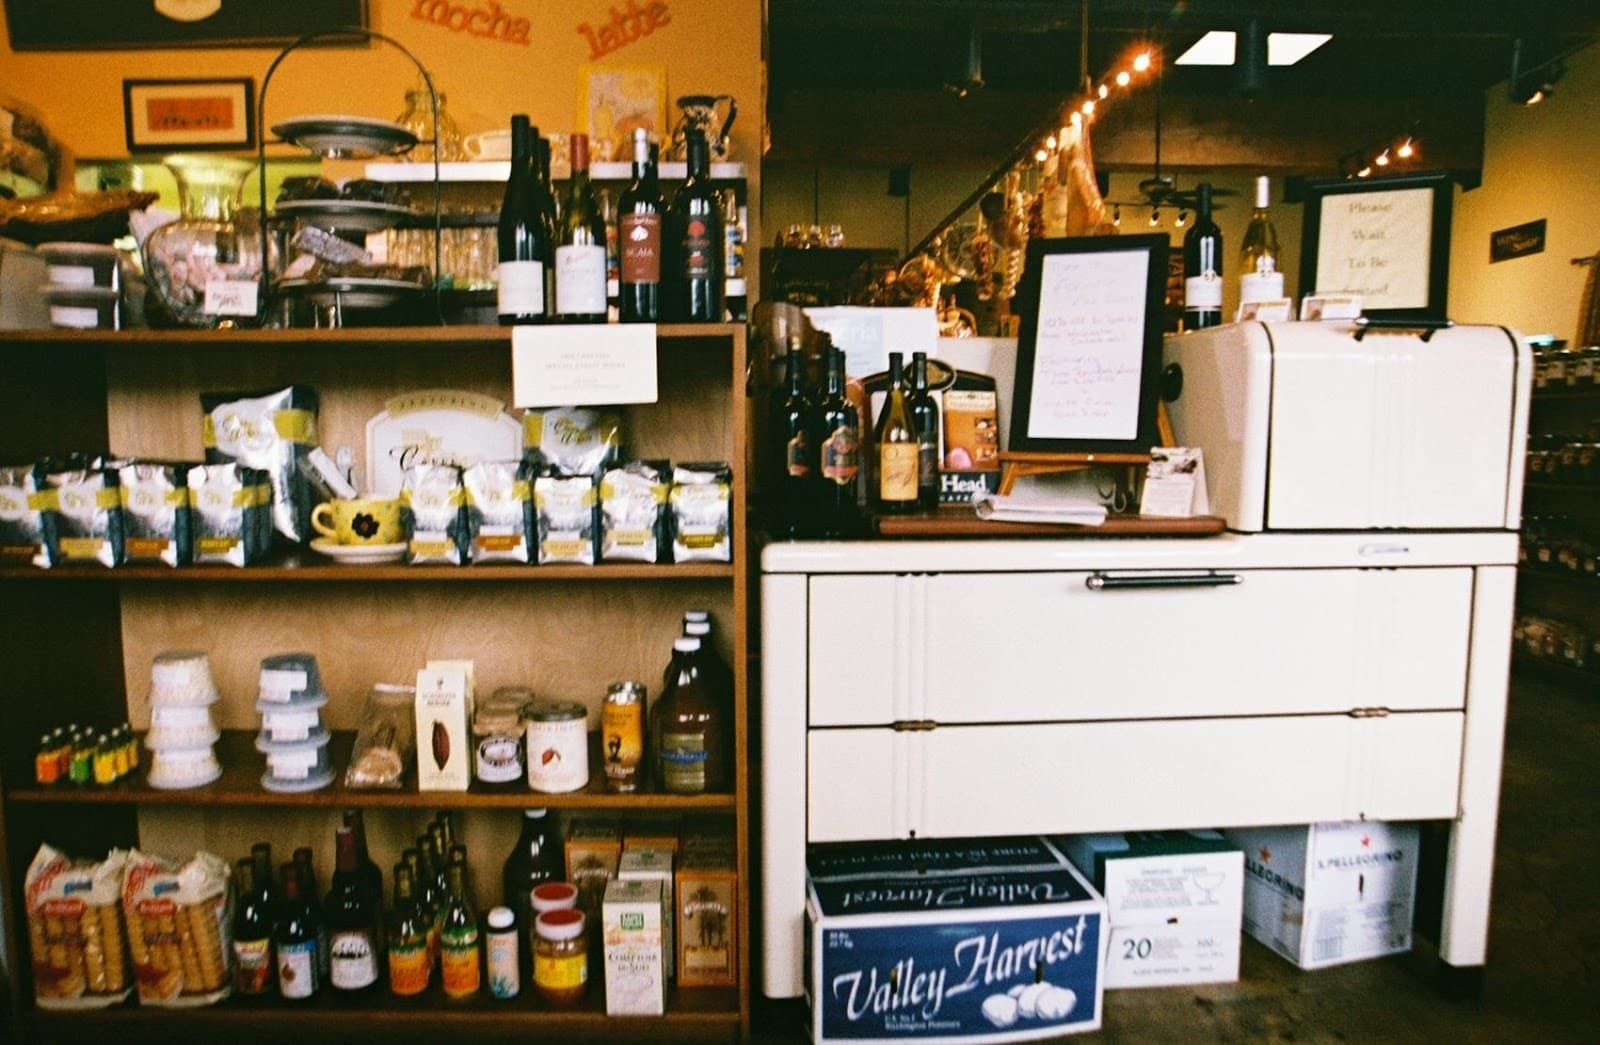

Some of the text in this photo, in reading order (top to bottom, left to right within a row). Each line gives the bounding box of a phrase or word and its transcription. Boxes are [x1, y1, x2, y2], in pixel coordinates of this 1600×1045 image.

[411, 0, 531, 46] mocha
[577, 0, 671, 61] latte
[941, 473, 986, 493] Head
[843, 882, 1070, 907] Valley Harvest
[945, 914, 1088, 998] Harvest
[1122, 937, 1152, 960] 20
[833, 956, 946, 1020] Valley
